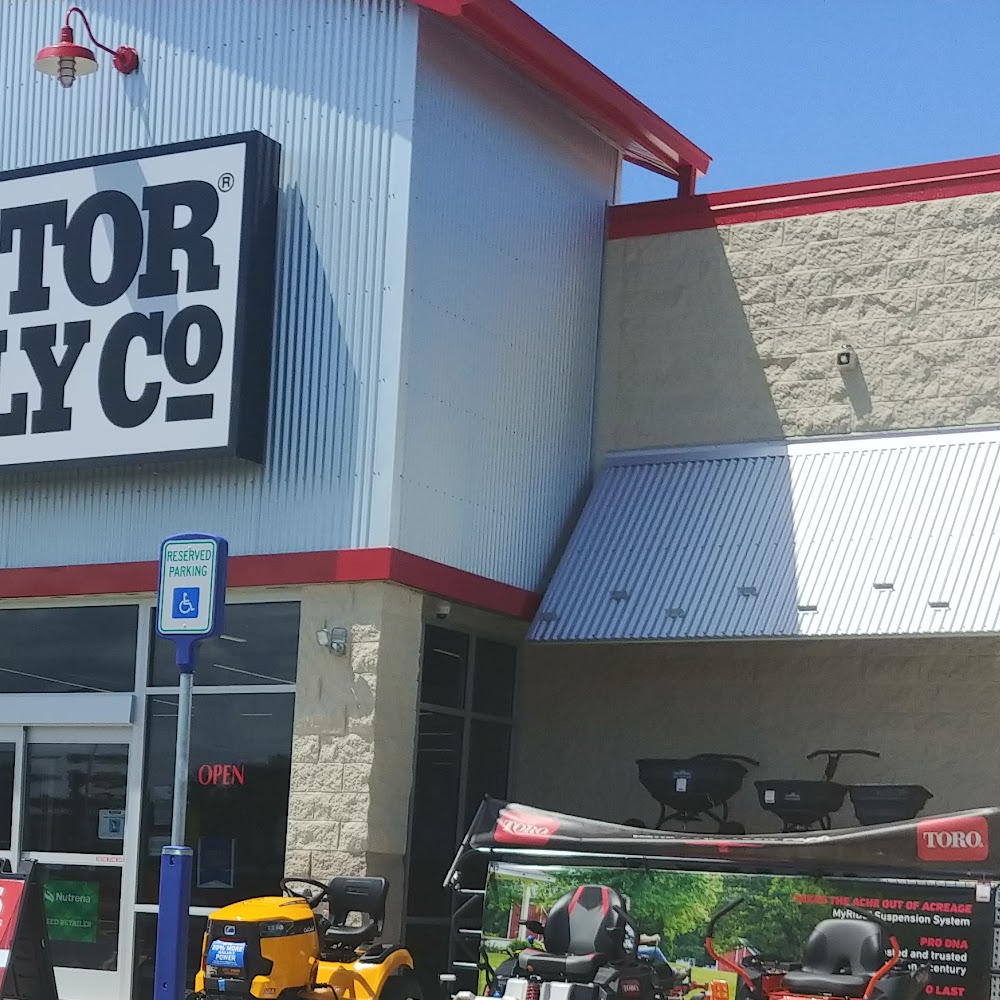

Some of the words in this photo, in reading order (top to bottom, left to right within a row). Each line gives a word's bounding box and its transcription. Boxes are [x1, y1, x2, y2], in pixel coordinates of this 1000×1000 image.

[167, 549, 211, 562] RESERVED
[169, 565, 207, 577] PARKING
[198, 764, 245, 785] OPEN
[501, 819, 550, 835] TORO
[923, 831, 984, 848] TORO
[55, 892, 91, 903] Nutrena
[830, 896, 850, 906] THE
[882, 899, 904, 910] OUT
[906, 900, 919, 910] OF
[921, 901, 972, 914] ACREAGE
[60, 919, 92, 928] RETAILER
[874, 910, 931, 924] Suspension
[933, 914, 971, 927] System
[920, 937, 942, 947] PRO
[944, 939, 968, 949] DNA
[910, 950, 928, 960] and
[931, 951, 967, 962] trusted
[935, 986, 966, 997] LAST
